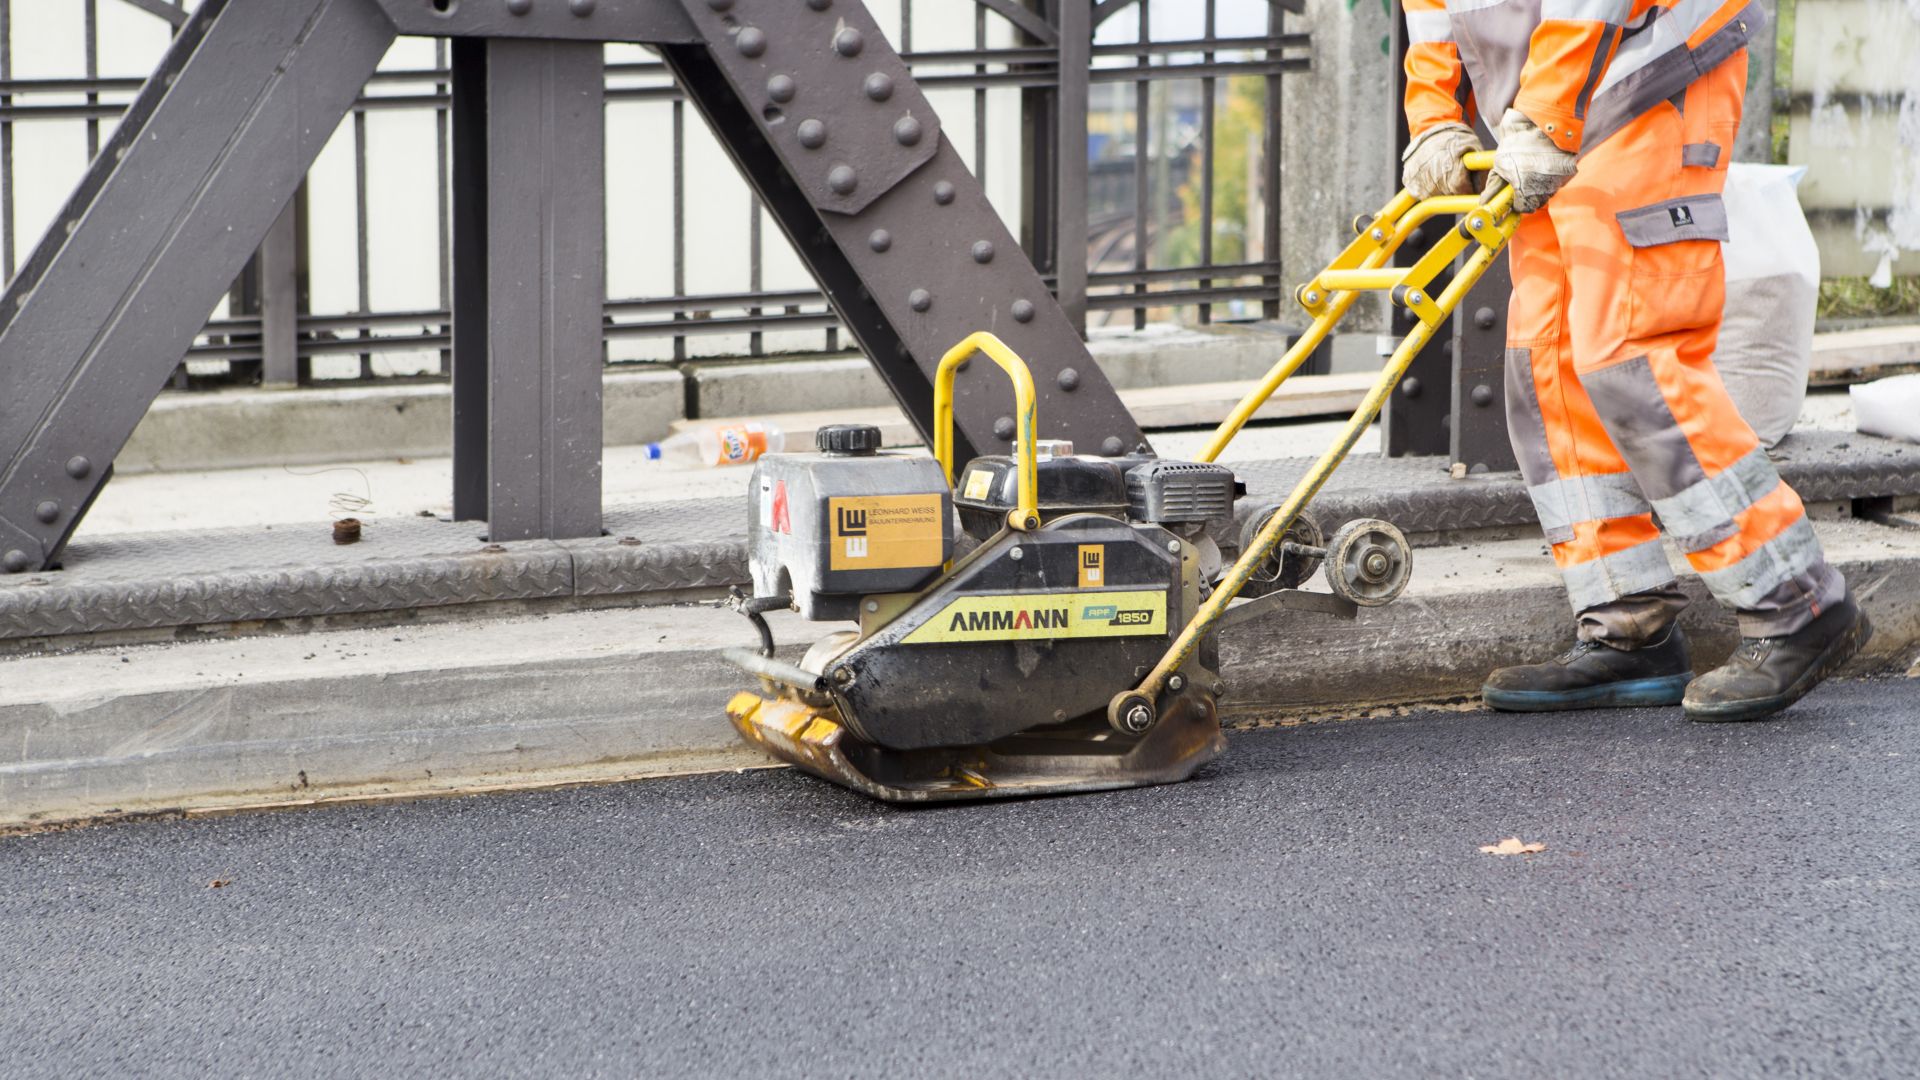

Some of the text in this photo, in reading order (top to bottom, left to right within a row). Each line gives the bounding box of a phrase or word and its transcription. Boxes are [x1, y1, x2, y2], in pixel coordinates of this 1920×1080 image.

[868, 506, 936, 517] LEONHARD WEISS
[949, 608, 1069, 632] AMMANN
[1117, 612, 1149, 624] 1850
